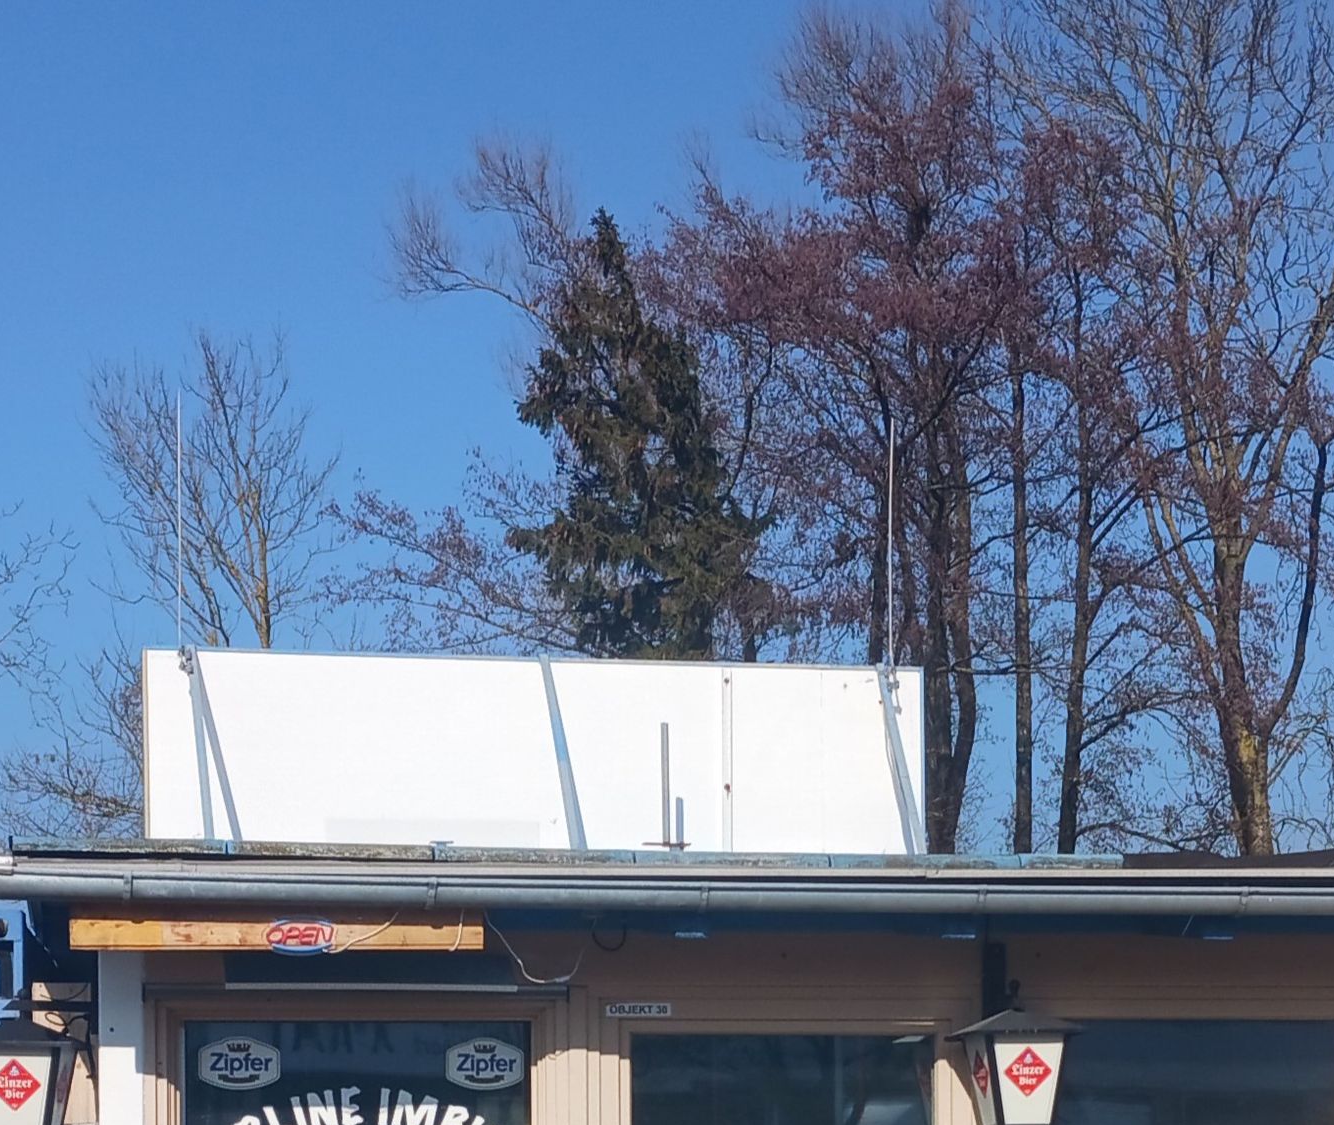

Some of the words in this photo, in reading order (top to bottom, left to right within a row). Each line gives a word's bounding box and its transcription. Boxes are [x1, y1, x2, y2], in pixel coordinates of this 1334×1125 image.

[266, 926, 334, 946] OPEN
[609, 1004, 653, 1015] OBJEKT
[210, 1053, 272, 1075] Zipfer
[455, 1053, 516, 1076] Zipfer
[1012, 1063, 1045, 1075] Linzer
[1019, 1076, 1038, 1085] Bier
[4, 1089, 26, 1099] Bier
